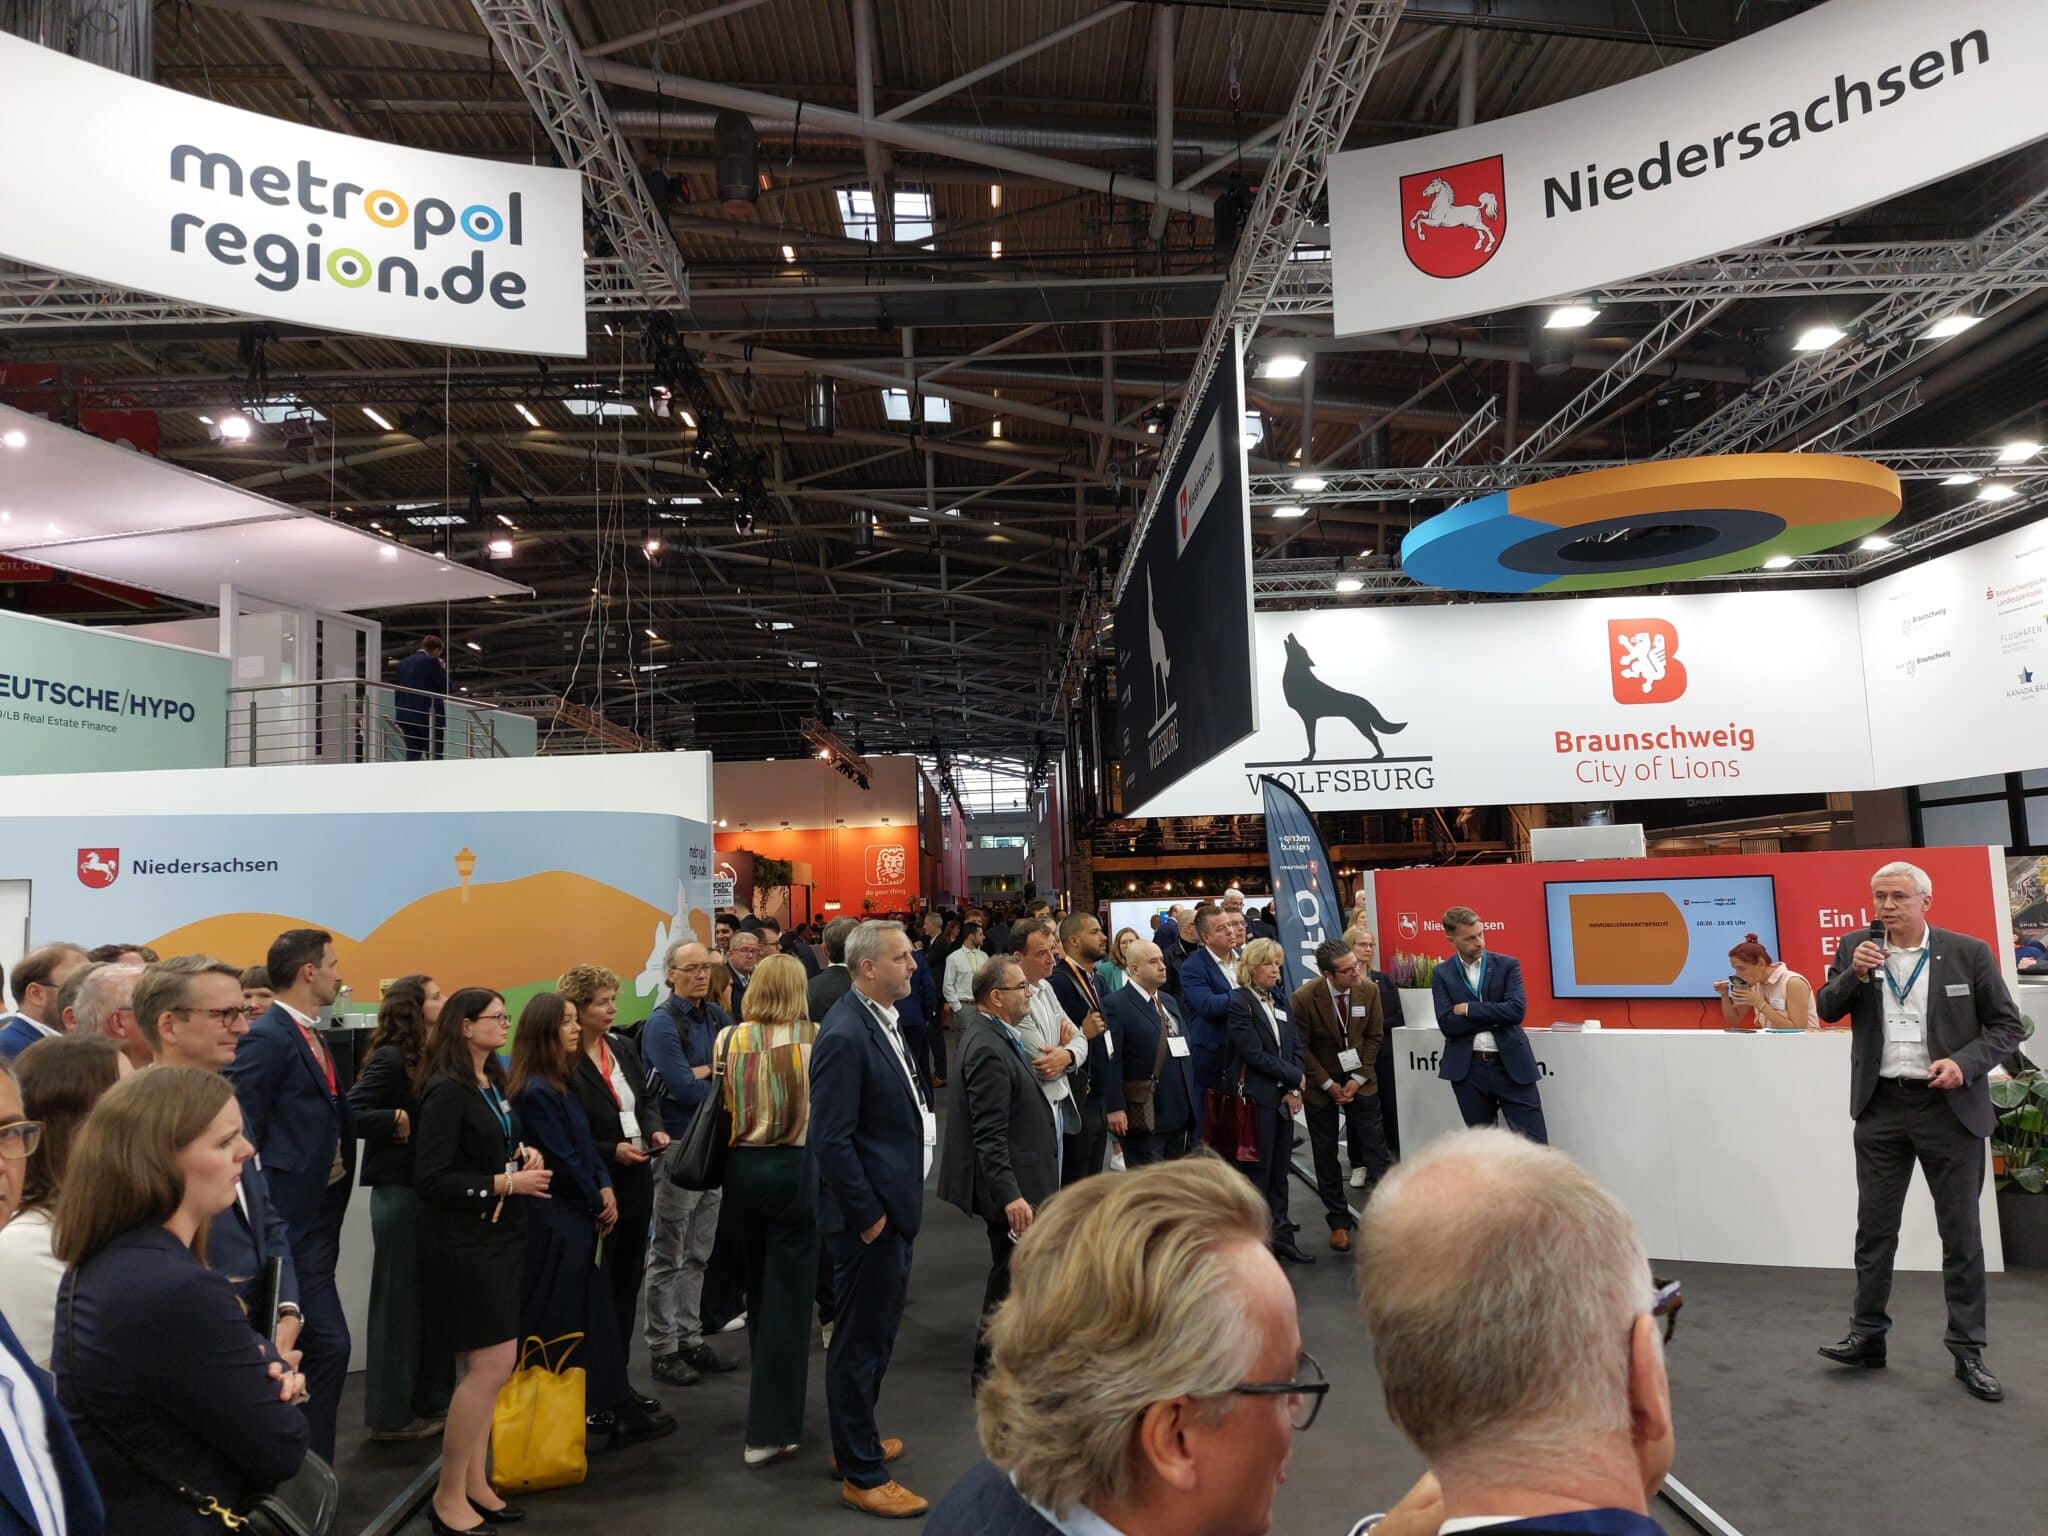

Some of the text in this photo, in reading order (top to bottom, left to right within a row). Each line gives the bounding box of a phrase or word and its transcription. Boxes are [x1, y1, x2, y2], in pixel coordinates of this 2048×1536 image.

[1544, 28, 1990, 218] Niedersachsen
[170, 144, 522, 250] metropol
[170, 212, 527, 310] region.de
[23, 713, 45, 725] Real
[48, 716, 79, 729] Estate
[81, 720, 118, 733] Finance
[1554, 722, 1755, 753] Braunschweig
[1576, 755, 1741, 788] City of Lions
[133, 857, 278, 875] Niedersachsen
[1818, 908, 1854, 928] Ein
